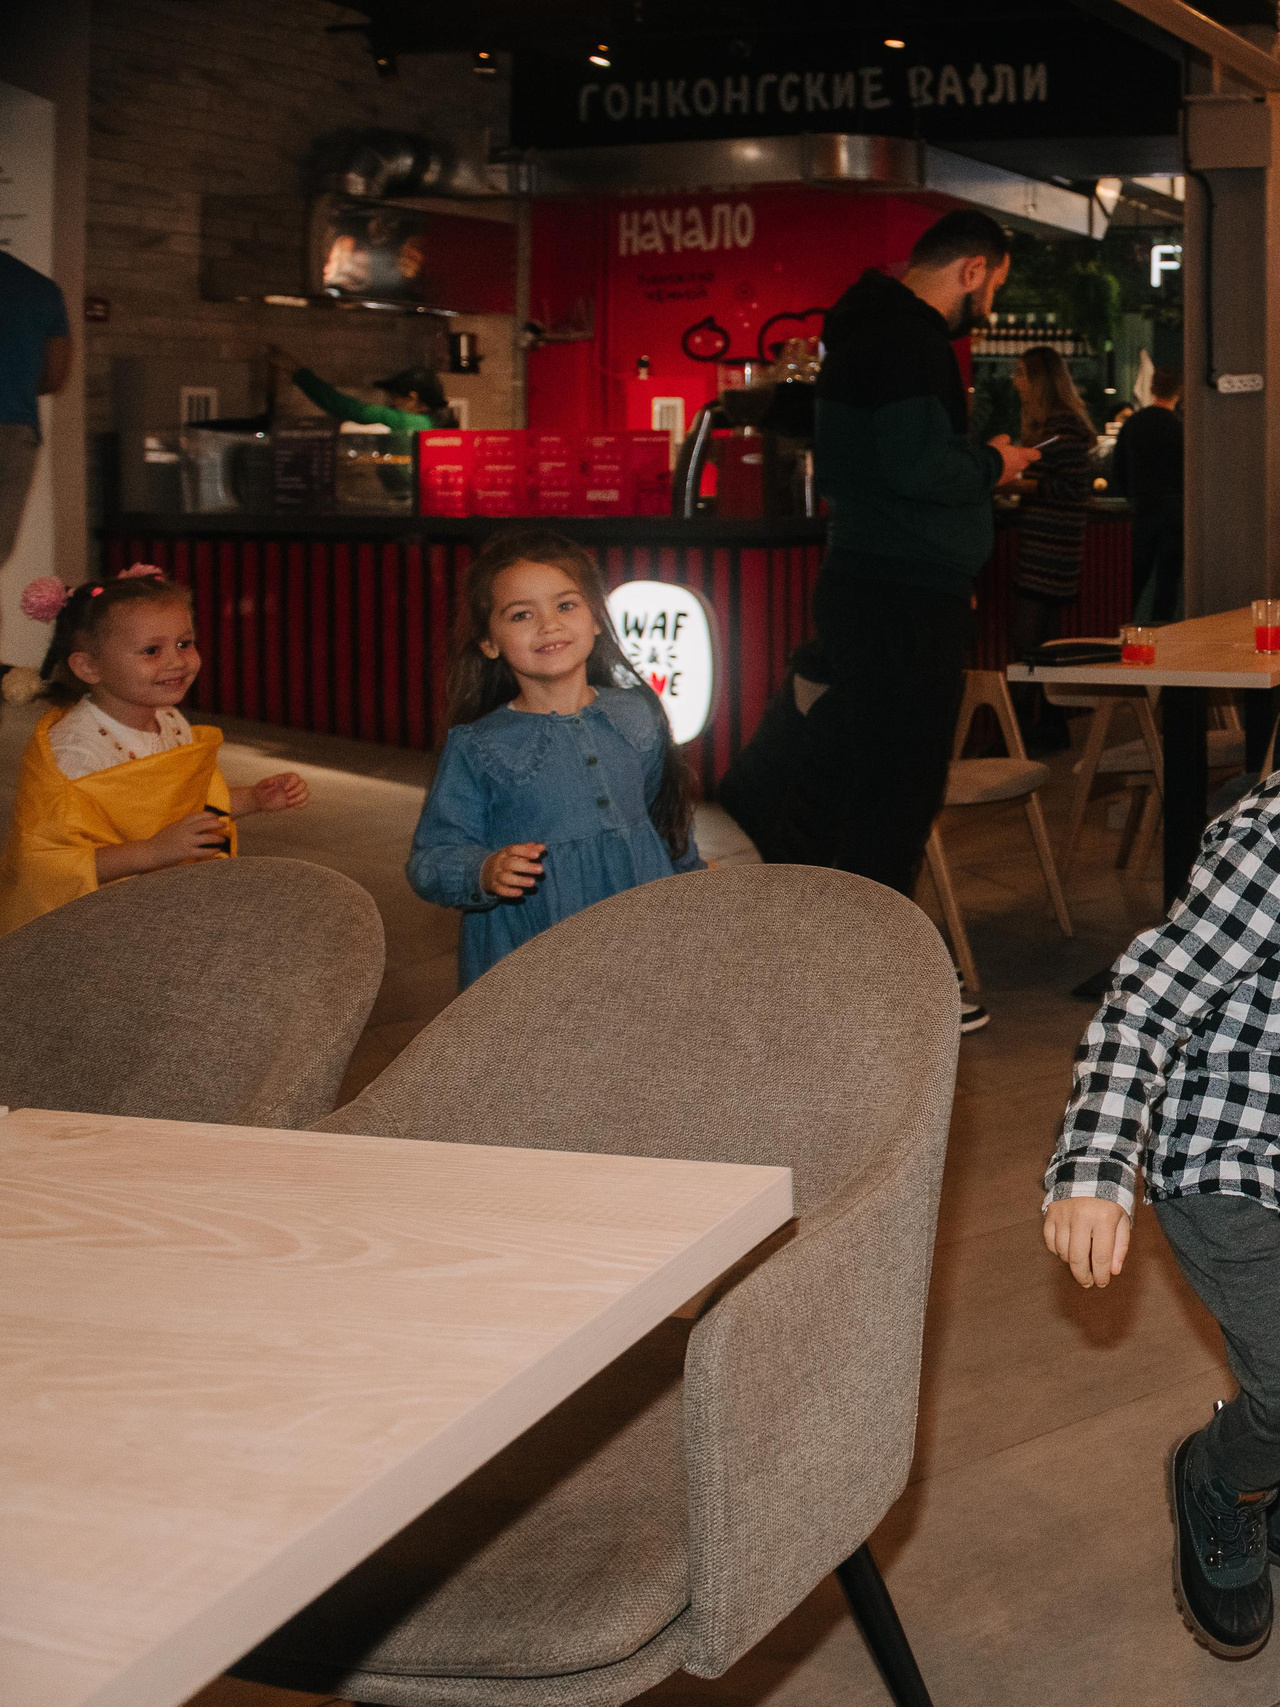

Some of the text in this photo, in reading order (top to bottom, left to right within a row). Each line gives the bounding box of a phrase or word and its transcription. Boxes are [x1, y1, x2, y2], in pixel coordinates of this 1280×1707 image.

[577, 62, 1050, 122] ГОНКОНГСКИЕ ВАФЛИ
[622, 611, 687, 641] WAF
